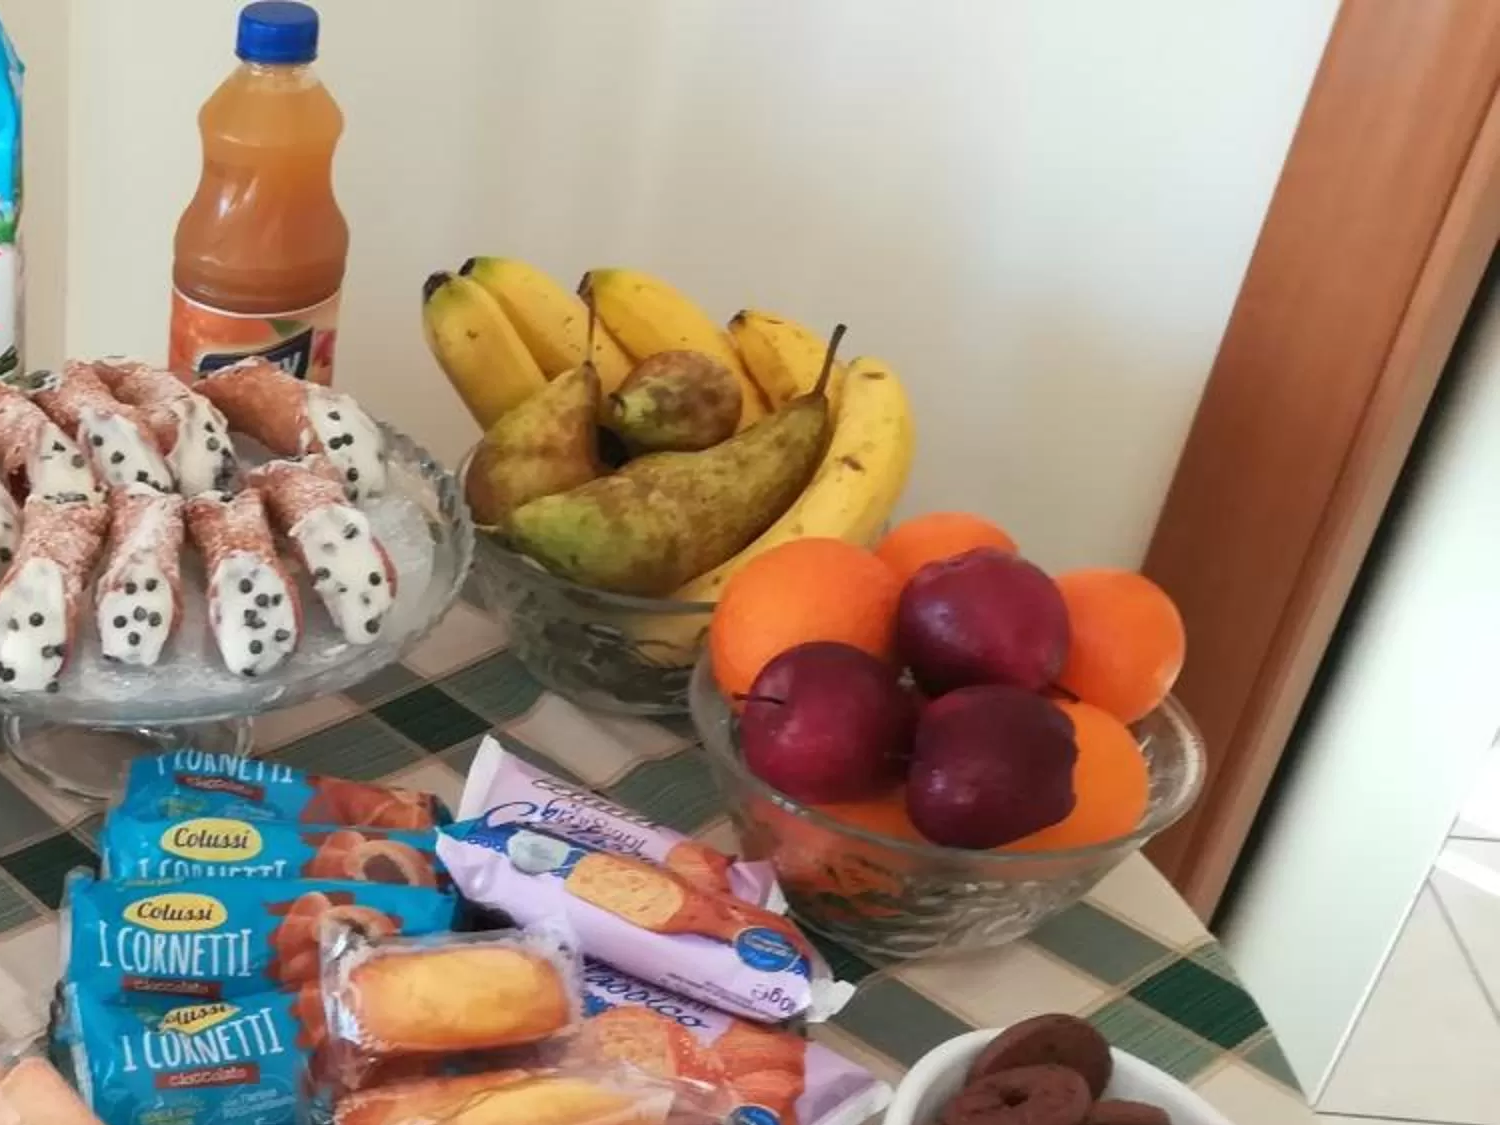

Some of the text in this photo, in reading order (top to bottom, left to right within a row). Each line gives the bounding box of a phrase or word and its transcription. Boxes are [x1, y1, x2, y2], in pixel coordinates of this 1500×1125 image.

[174, 827, 250, 849] Colussi
[137, 902, 215, 921] Colussi
[99, 920, 253, 977] I CORNETTI
[122, 1007, 284, 1072] I CORNETTI
